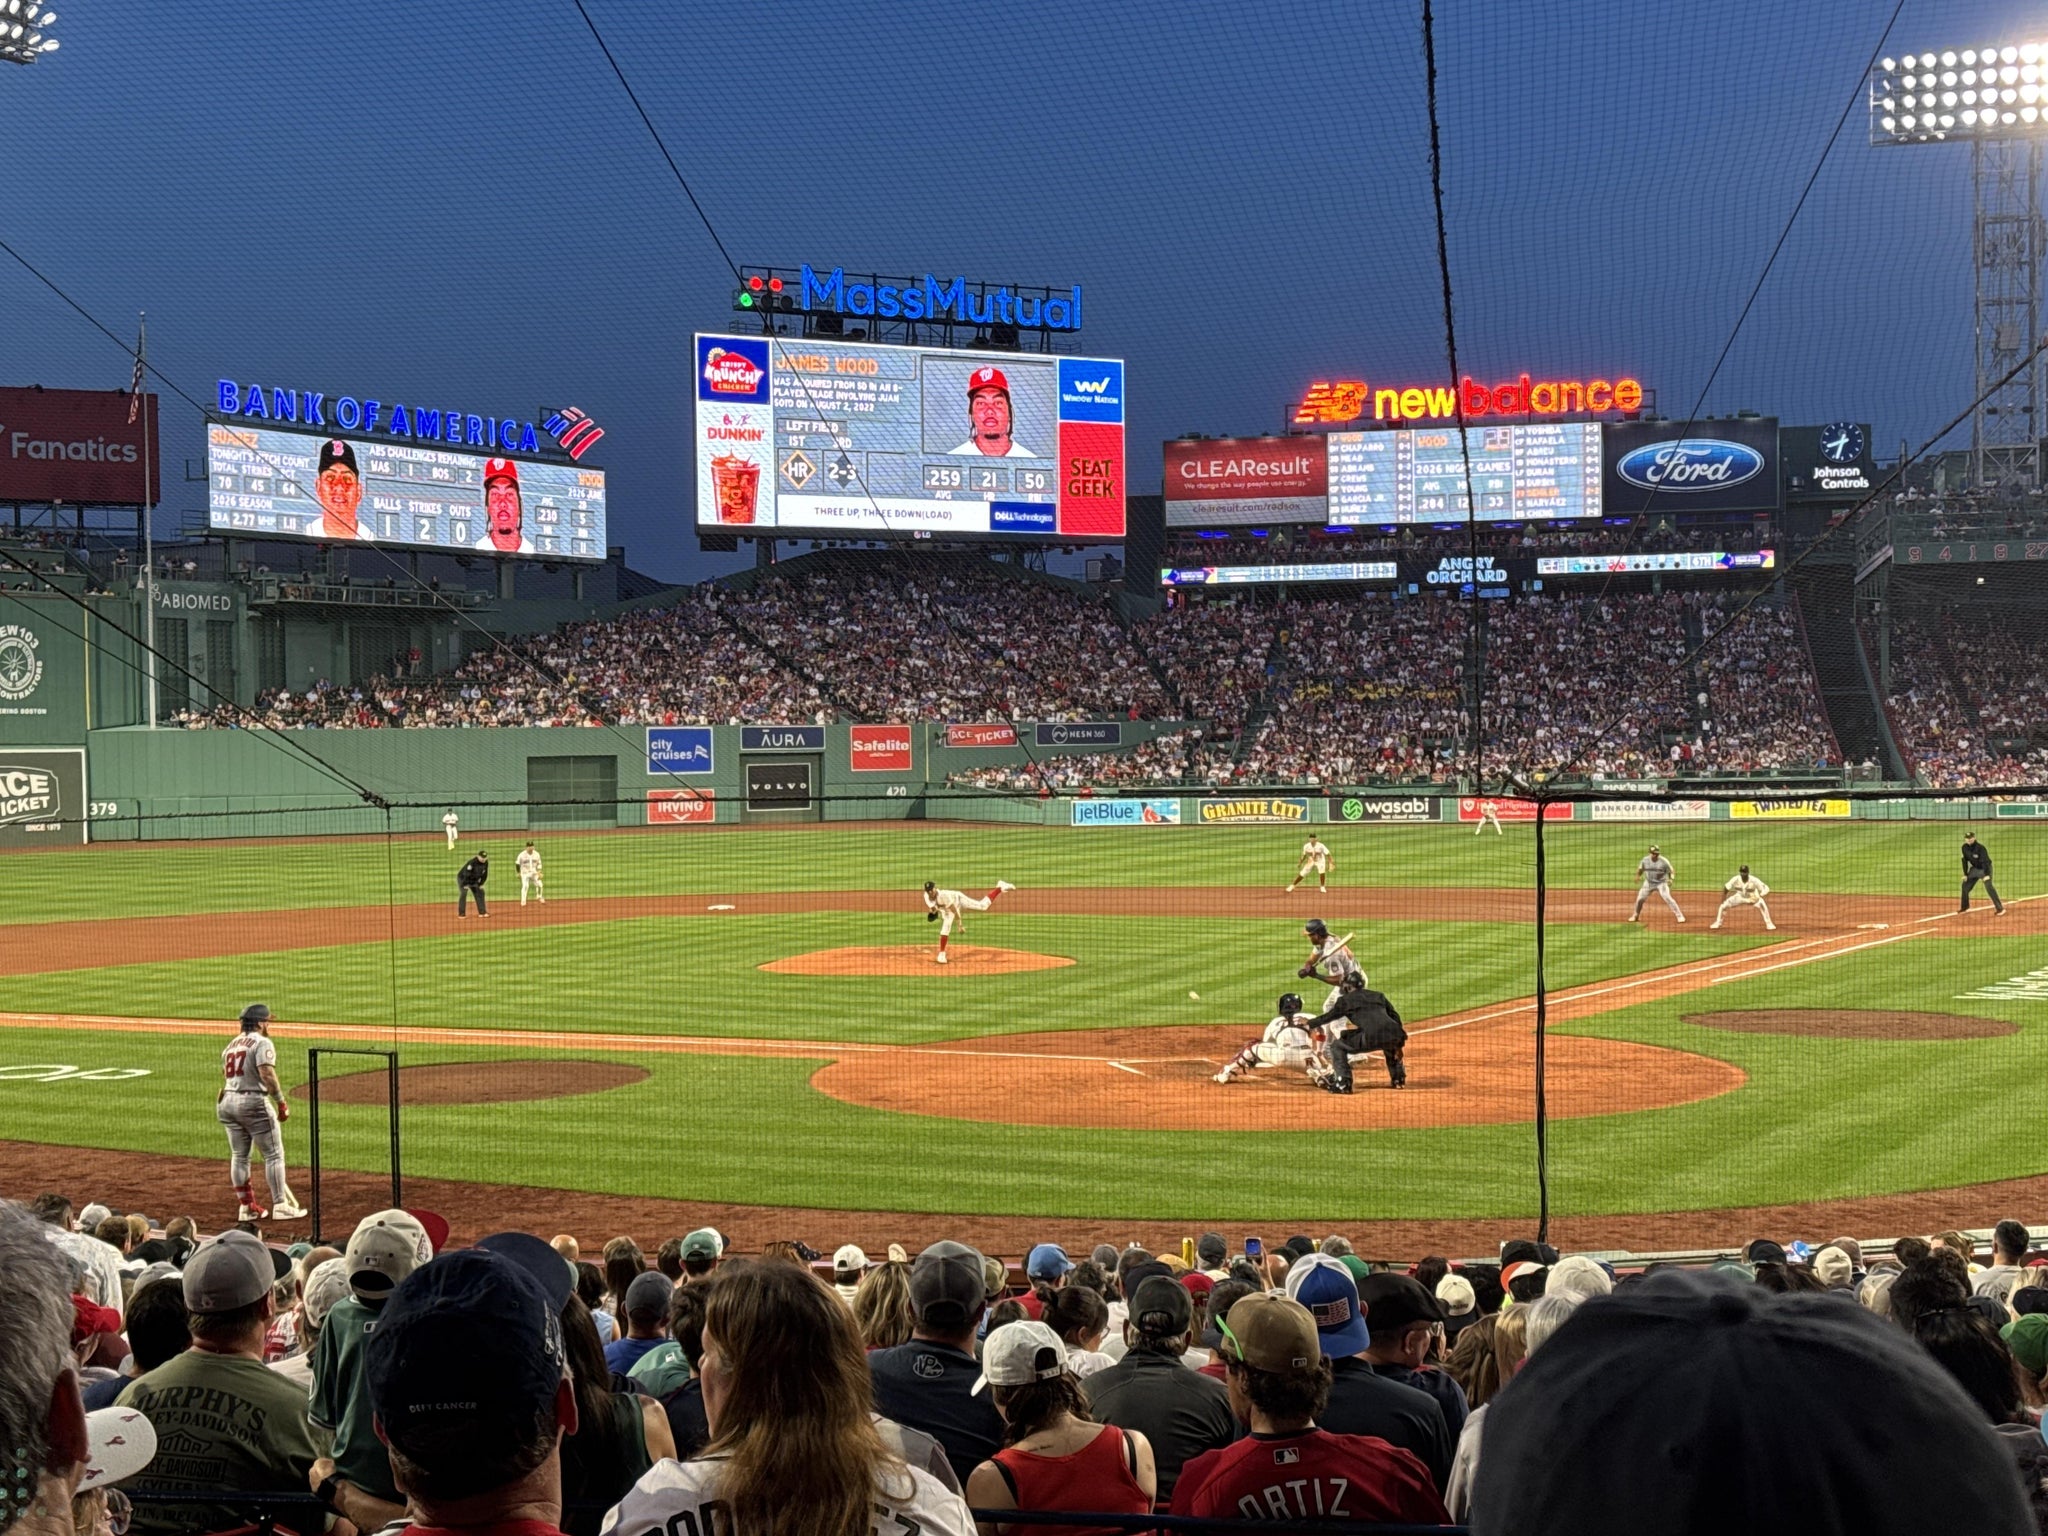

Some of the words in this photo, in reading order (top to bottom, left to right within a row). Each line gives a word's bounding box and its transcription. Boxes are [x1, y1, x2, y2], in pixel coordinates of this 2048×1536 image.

[801, 263, 1082, 330] MassMutual
[776, 354, 829, 372] JAMES
[836, 357, 878, 375] WOOD
[704, 365, 764, 384] KRUNCHY
[834, 380, 855, 389] FROM
[774, 388, 806, 397] PLAYER
[836, 391, 876, 401] INVOLVING
[1375, 387, 1456, 420] new
[1462, 374, 1643, 417] balance
[854, 403, 874, 412] 2022
[218, 379, 325, 425] BANK
[337, 397, 380, 431] OF
[391, 404, 539, 452] AMERICA
[786, 420, 811, 431] LEFT
[707, 427, 765, 441] DUNKIN'
[11, 432, 138, 463] Fanatics
[369, 446, 386, 457] ABS
[212, 448, 254, 462] TONIGHT'S
[282, 456, 309, 469] COUNT
[1647, 447, 1734, 483] Ford
[212, 461, 237, 473] TOTAL
[242, 465, 273, 477] STRIKES
[370, 462, 390, 474] WAS
[432, 467, 449, 480] BOS
[465, 471, 473, 483] 2
[788, 463, 808, 478] HR
[1071, 458, 1113, 478] SEAT
[1416, 464, 1442, 474] 2026
[1477, 462, 1511, 472] GAMES
[1814, 467, 1860, 479] Johnson
[218, 476, 232, 489] 70
[251, 480, 264, 492] 45
[925, 470, 961, 486] .259
[982, 472, 996, 487] 21
[1025, 473, 1045, 489] 50
[1247, 480, 1270, 489] people
[1822, 477, 1871, 490] Controls
[935, 491, 952, 499] AVG
[984, 492, 995, 501] HR
[1068, 479, 1115, 498] GEEK
[213, 495, 236, 506] 2026
[238, 496, 272, 509] SEASON
[373, 497, 402, 511] BALLS
[408, 501, 442, 515] STRIKES
[450, 504, 471, 518] OUTS
[1488, 496, 1504, 507] 33
[815, 507, 844, 516] THREE
[847, 508, 860, 518] UP,
[863, 508, 892, 518] THREE
[419, 518, 430, 540] 2
[455, 521, 466, 543] 0
[1908, 547, 1922, 562] 9
[1938, 546, 1952, 561] 4
[1969, 545, 1977, 561] 1
[1994, 544, 2008, 559] 8
[2025, 543, 2048, 559] 27
[1439, 557, 1495, 570] ANGRY
[1426, 569, 1507, 583] ORCHARD
[161, 594, 231, 611] ABIOMED
[19, 627, 39, 649] 103
[950, 731, 974, 741] ACE
[974, 729, 1014, 744] TICKET
[1069, 731, 1092, 739] NESN
[651, 739, 673, 752] city
[852, 741, 910, 752] Safelite
[651, 750, 693, 760] cruises
[751, 782, 807, 791] VOLVO
[886, 786, 907, 797] 420
[89, 802, 117, 816] 379
[657, 801, 704, 813] IRVING
[1079, 802, 1133, 822] jetBlue
[1202, 801, 1268, 820] GRANITE
[1271, 800, 1305, 819] CITY
[1365, 797, 1429, 814] wasabi
[1594, 804, 1621, 812] BANK
[1624, 804, 1637, 812] OF
[1639, 803, 1684, 812] AMERICA
[1753, 800, 1803, 815] TWISTED
[1806, 801, 1827, 814] TEA
[226, 1050, 247, 1078] 87
[409, 1403, 432, 1413] DEFY
[436, 1402, 477, 1410] CANCER
[1238, 1478, 1350, 1520] ORTIZ
